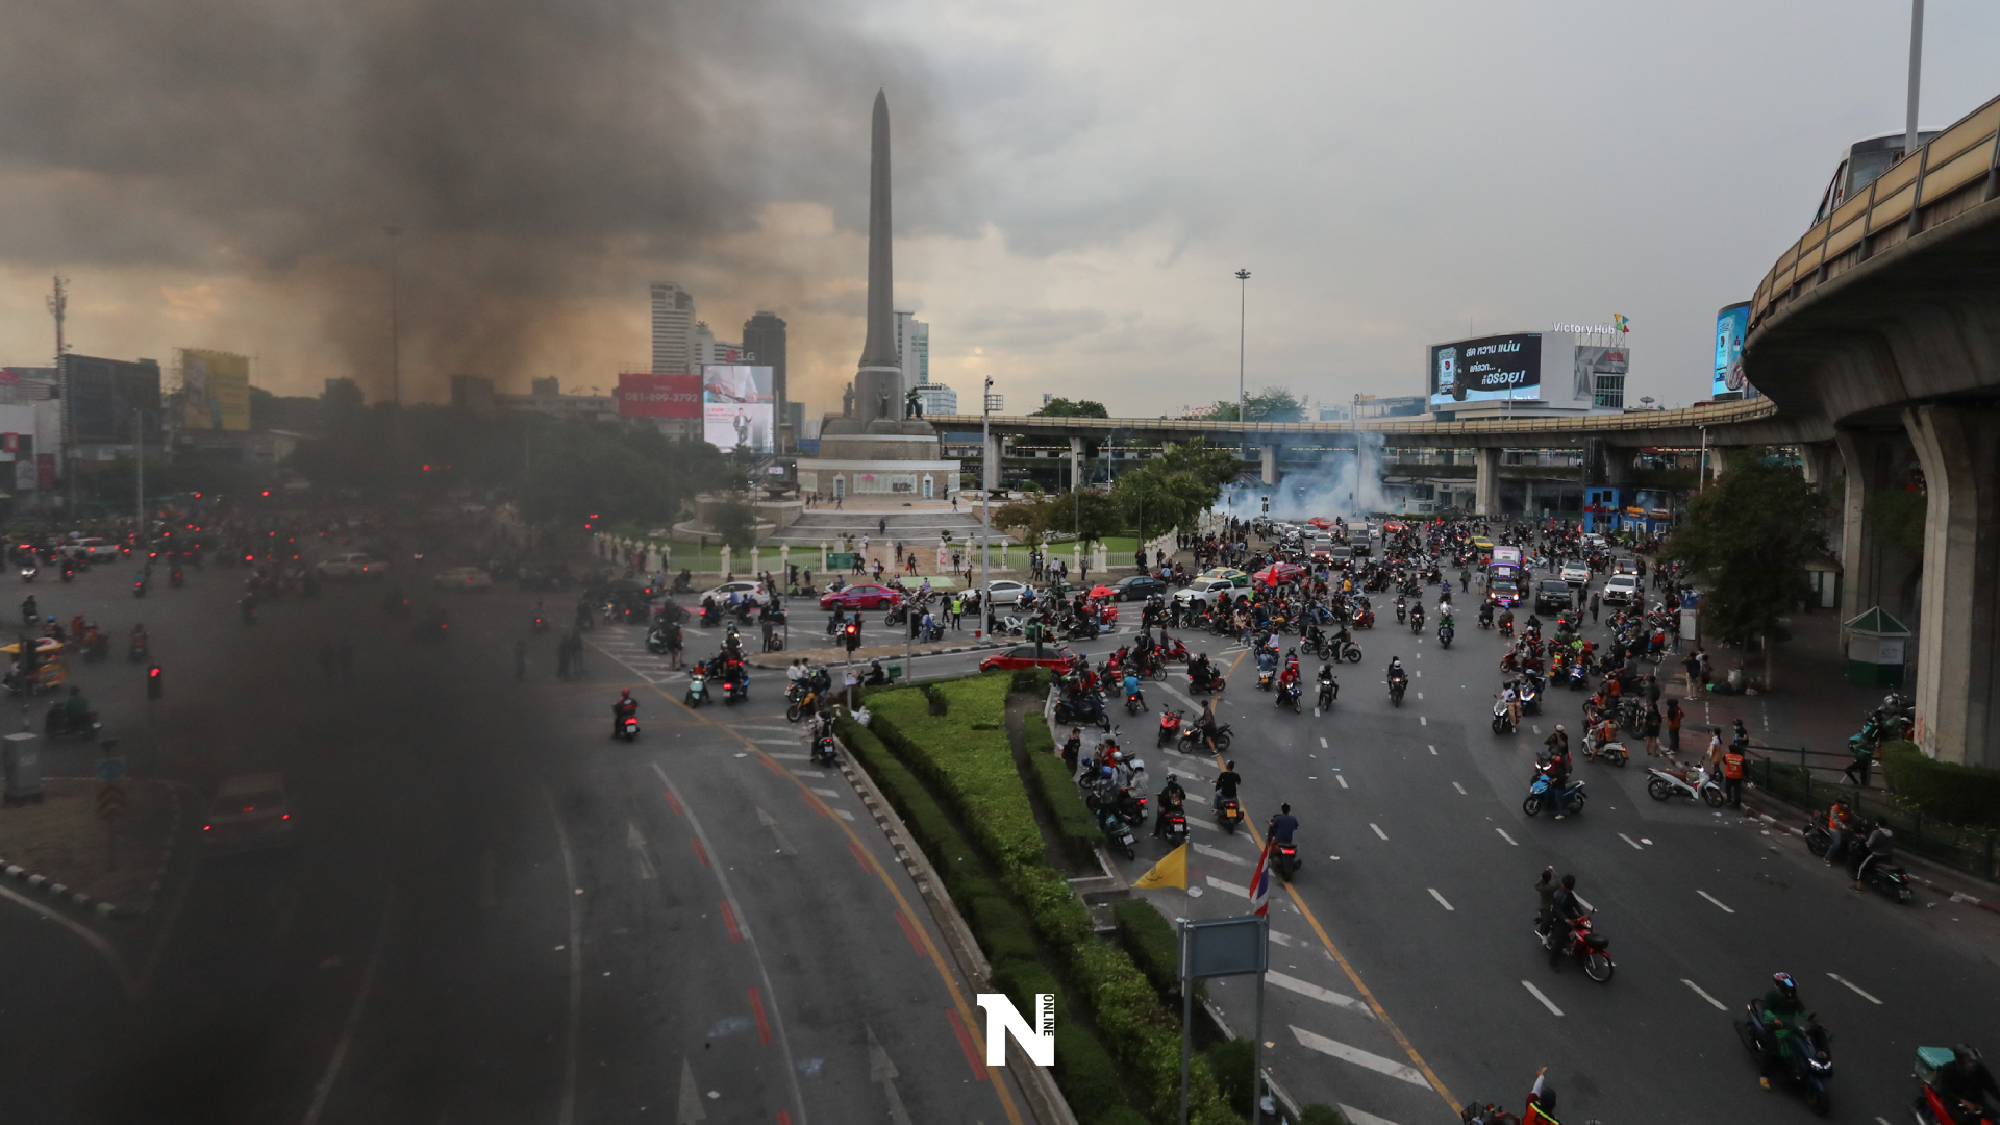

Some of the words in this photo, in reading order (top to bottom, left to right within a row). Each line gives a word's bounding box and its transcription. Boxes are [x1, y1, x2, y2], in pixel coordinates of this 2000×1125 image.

[1553, 322, 1593, 336] Victory
[1594, 324, 1616, 334] Hub
[1466, 348, 1476, 357] สด
[1477, 345, 1497, 355] หวาน
[1498, 339, 1520, 353] แน่น
[740, 350, 755, 361] LG
